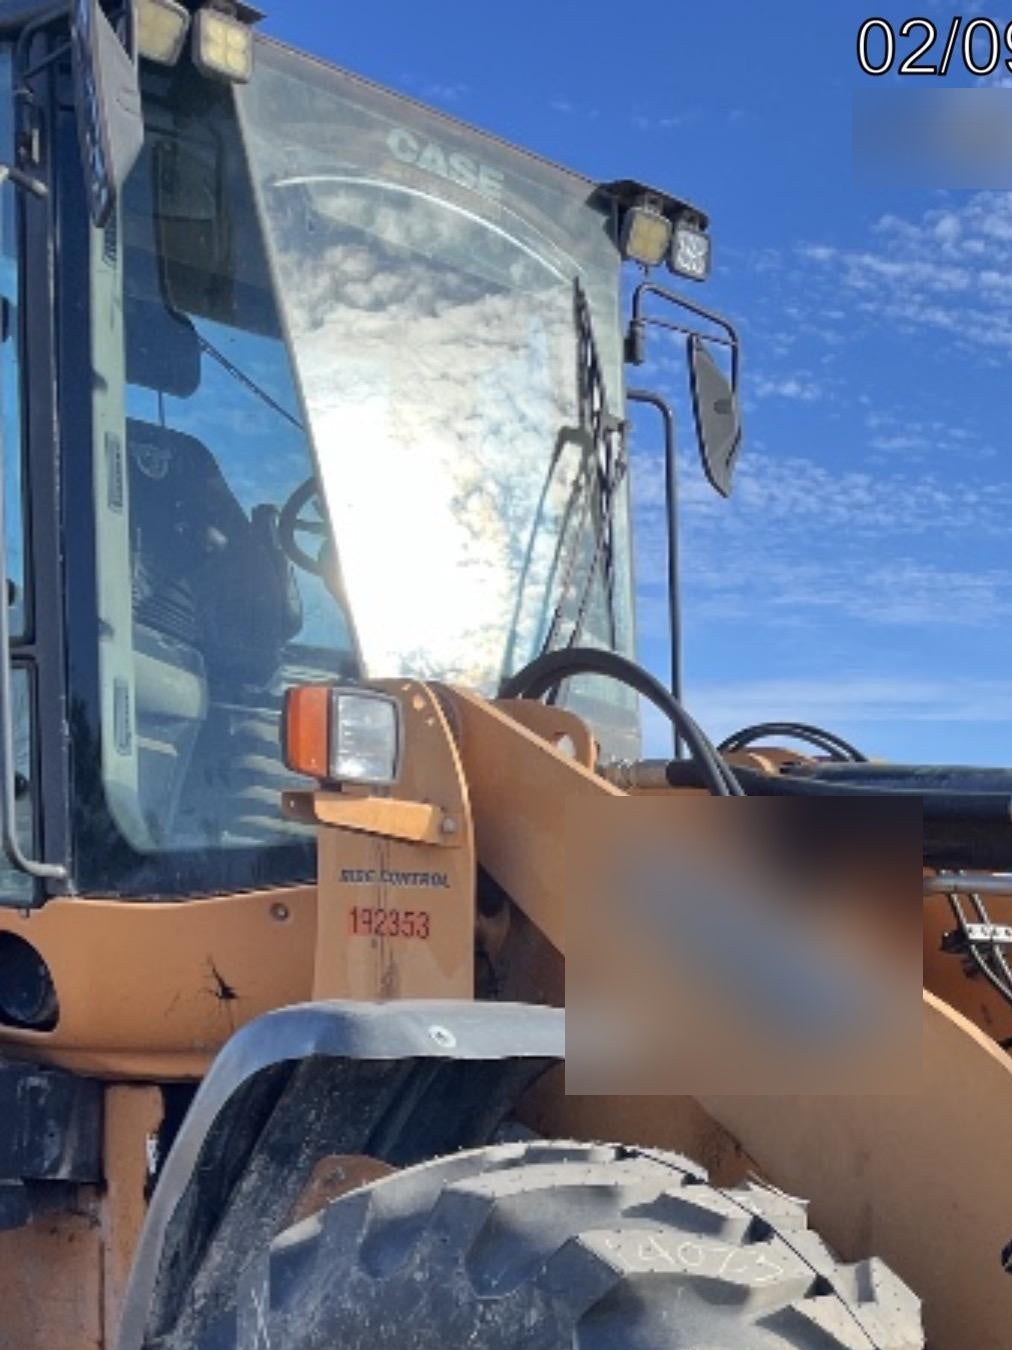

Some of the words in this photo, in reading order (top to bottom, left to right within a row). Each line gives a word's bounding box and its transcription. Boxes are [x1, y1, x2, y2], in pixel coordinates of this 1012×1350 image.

[386, 127, 505, 197] CASE
[380, 870, 451, 889] CONTROL
[349, 905, 430, 940] 192353
